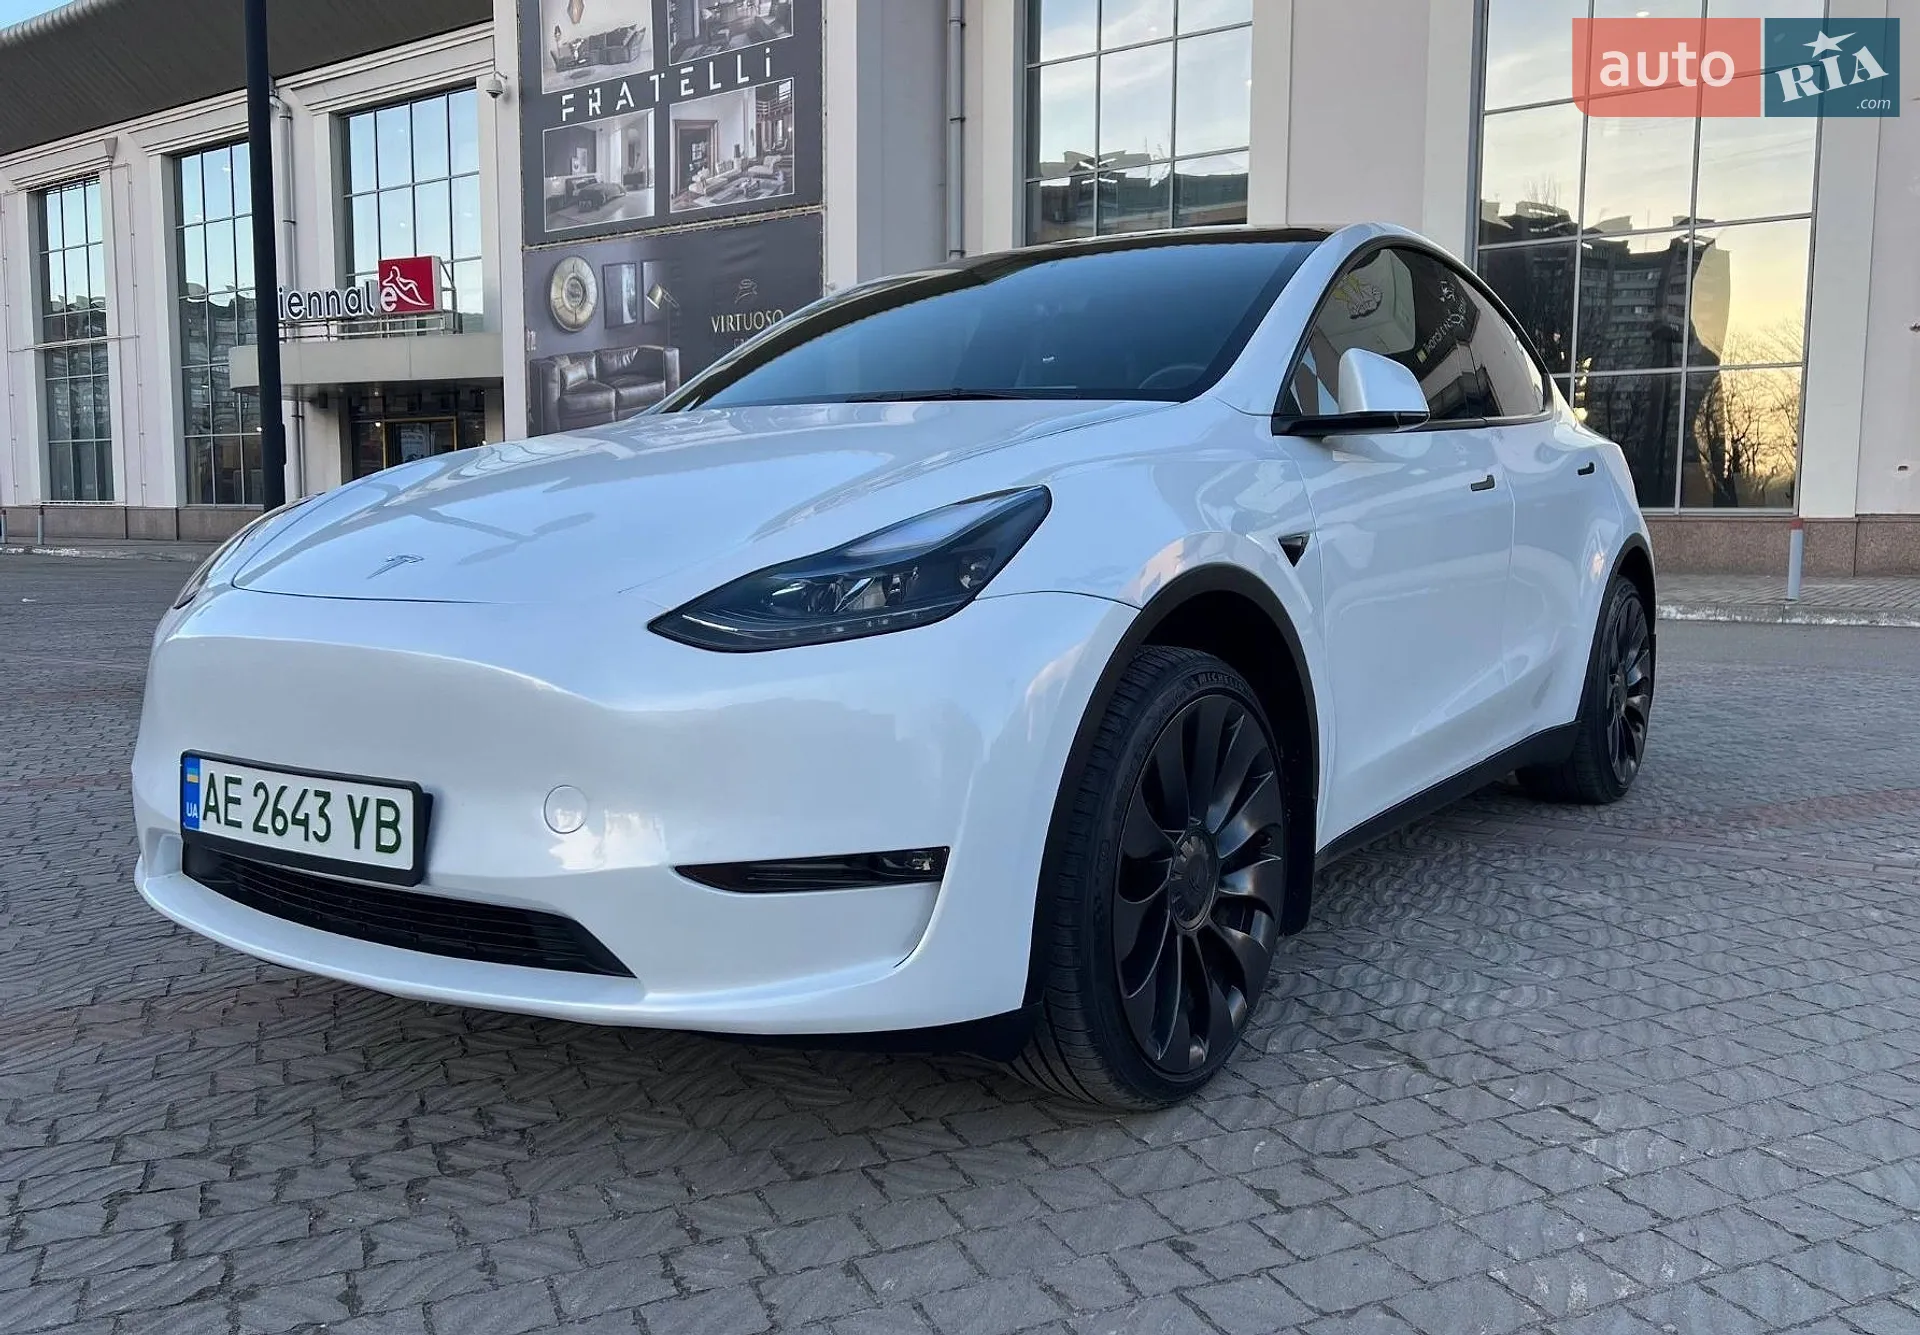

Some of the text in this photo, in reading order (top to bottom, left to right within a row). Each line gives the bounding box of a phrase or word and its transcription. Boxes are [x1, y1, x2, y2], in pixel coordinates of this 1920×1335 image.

[278, 280, 398, 320] iennale
[711, 309, 784, 333] VIRTUOSO
[186, 802, 198, 818] UA
[203, 772, 402, 854] AE 2643 YB
